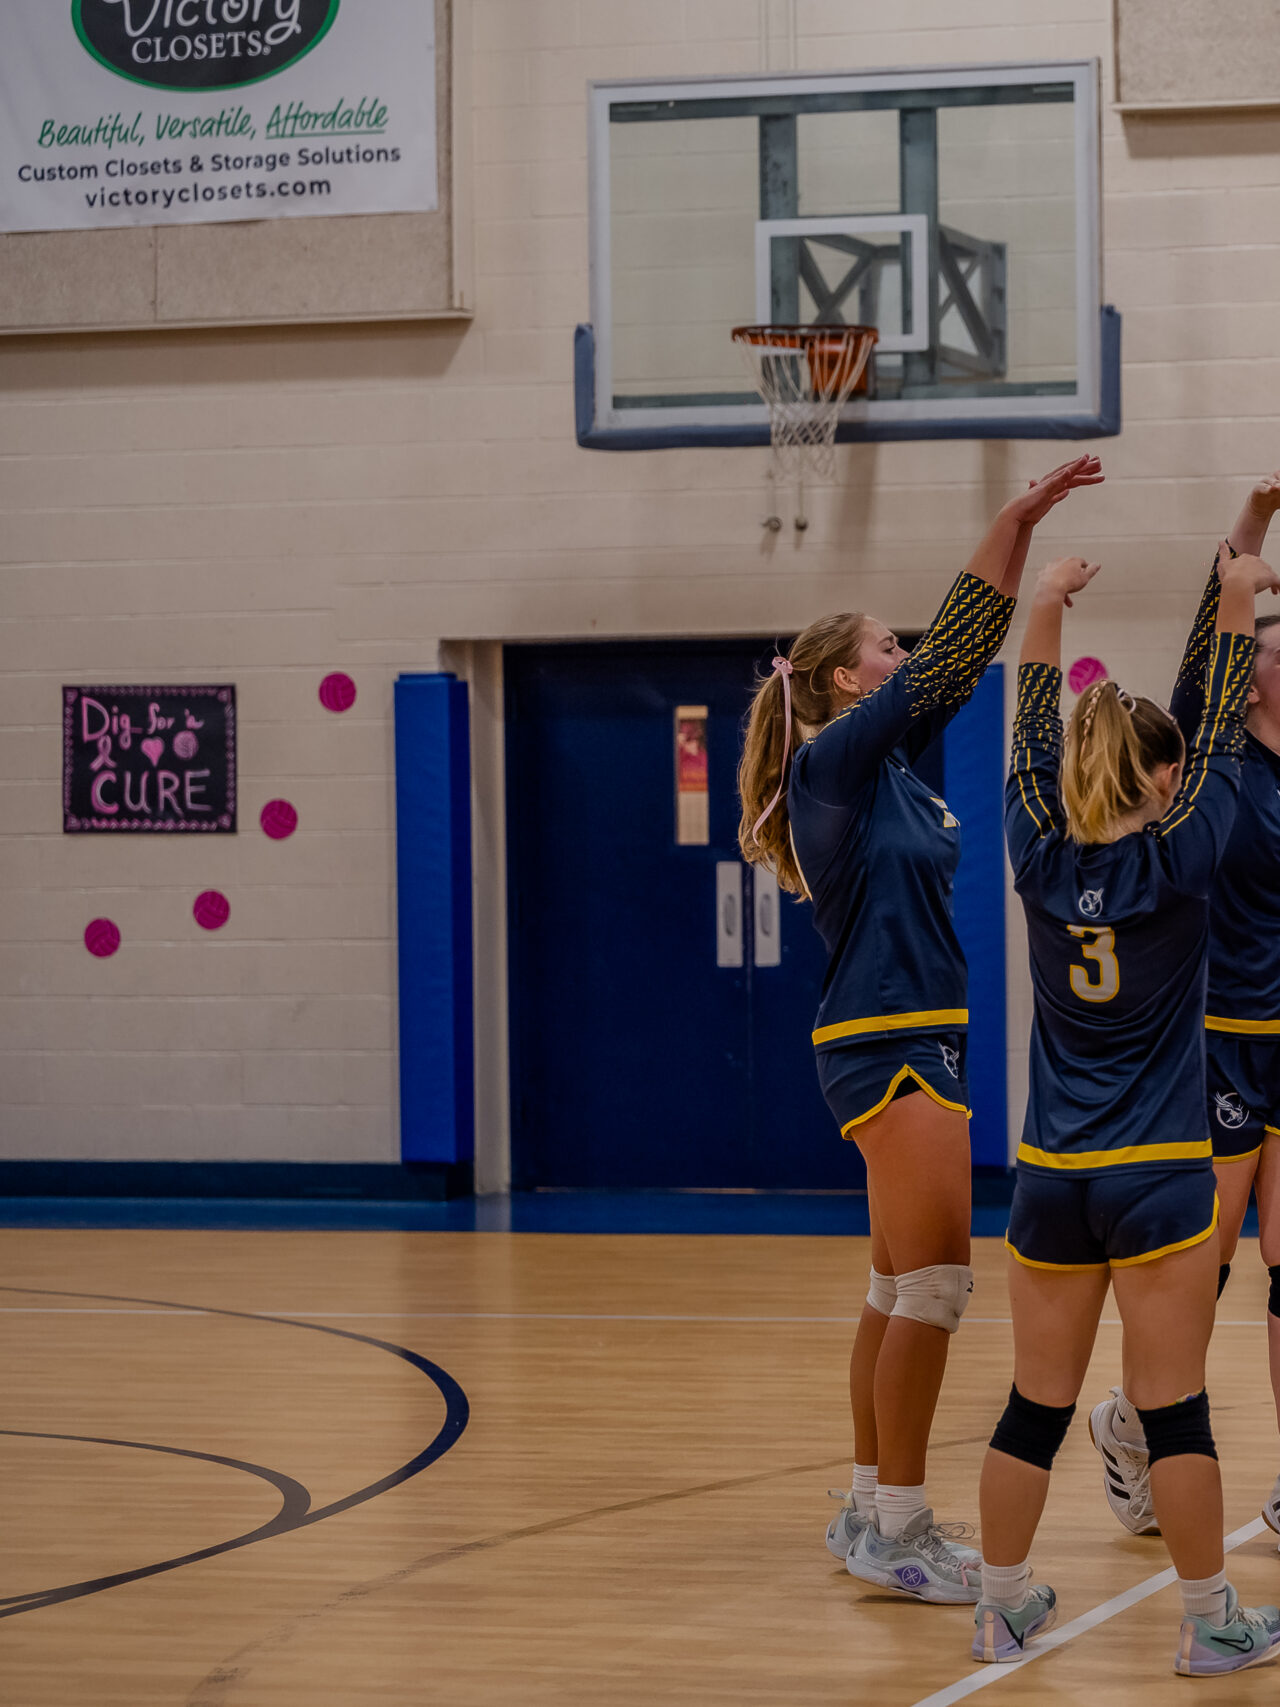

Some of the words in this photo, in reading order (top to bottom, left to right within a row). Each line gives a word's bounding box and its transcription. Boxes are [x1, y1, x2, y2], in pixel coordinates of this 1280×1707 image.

[38, 111, 145, 149] Beautiful,
[156, 105, 257, 141] Versatile,
[266, 96, 389, 138] Affordable
[18, 164, 98, 183] Custom
[105, 157, 183, 178] Closets
[190, 158, 204, 174] &
[211, 153, 290, 172] Storage
[298, 144, 401, 167] Solutions
[85, 178, 332, 208] victoryclosets.com
[147, 702, 175, 735] for
[90, 768, 213, 817] CURE
[1066, 924, 1120, 1003] 3
